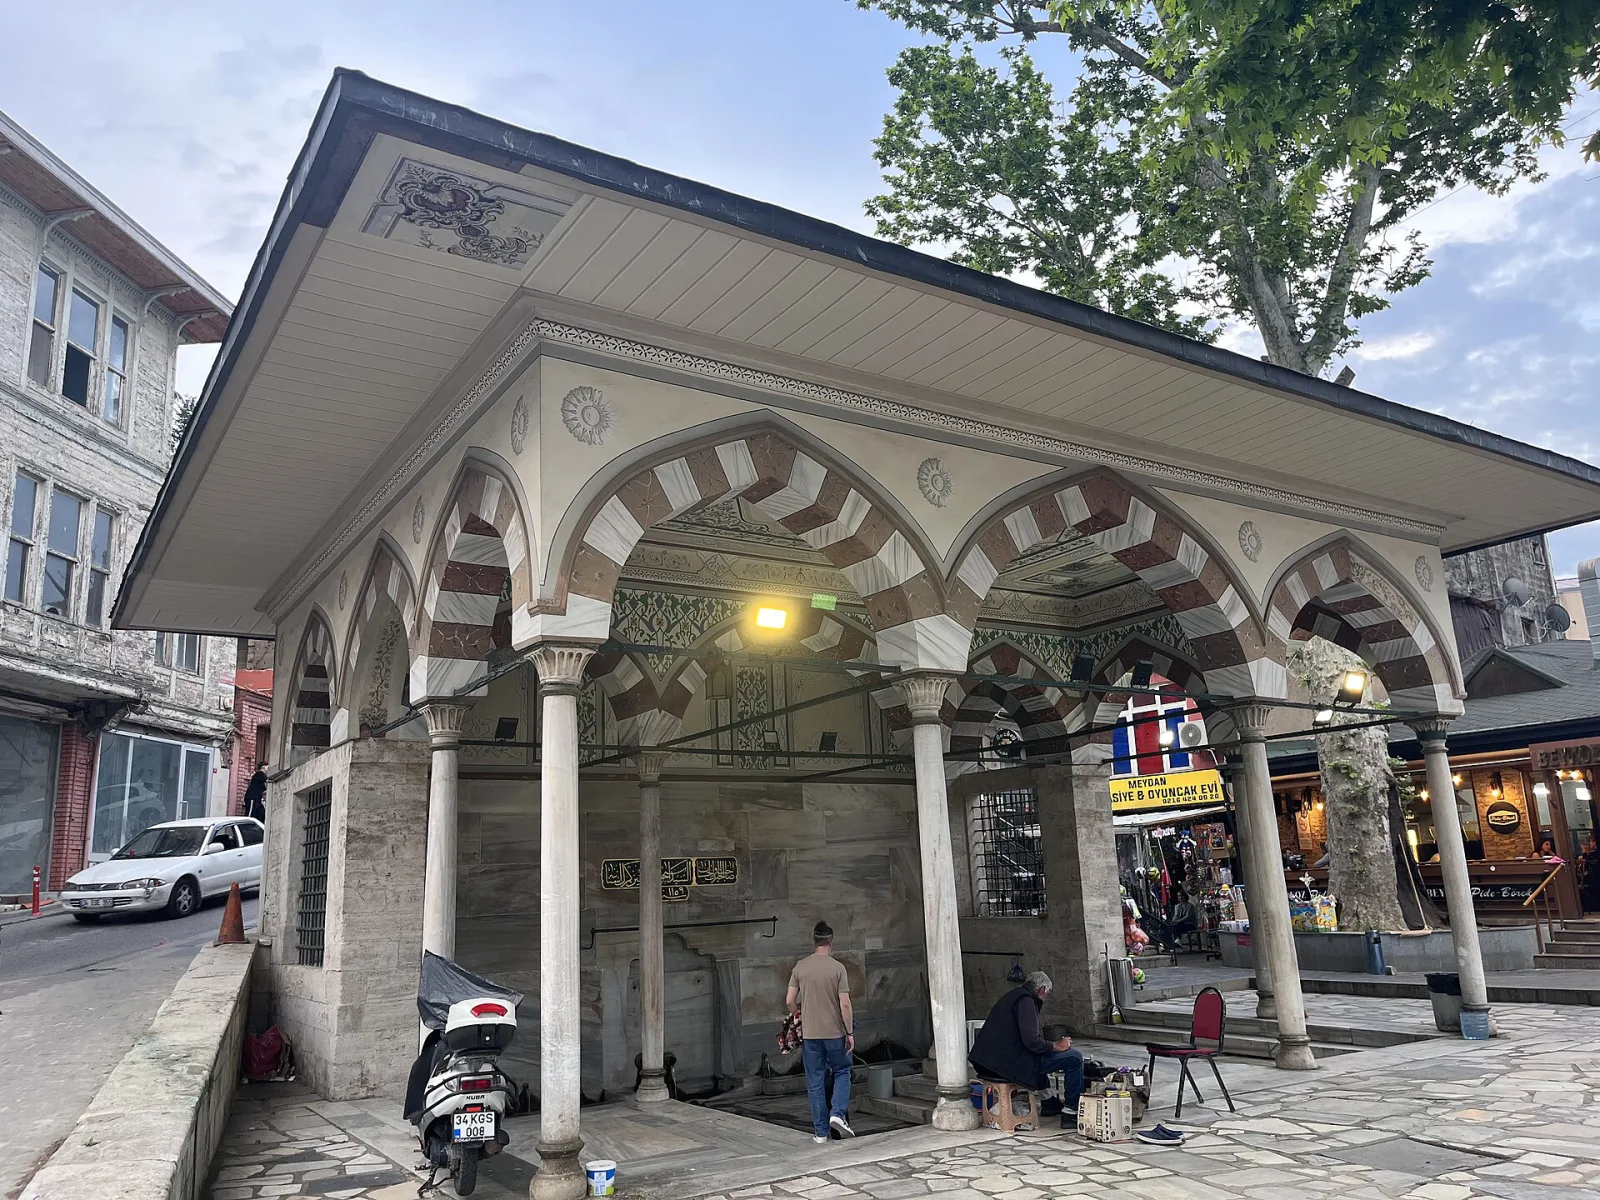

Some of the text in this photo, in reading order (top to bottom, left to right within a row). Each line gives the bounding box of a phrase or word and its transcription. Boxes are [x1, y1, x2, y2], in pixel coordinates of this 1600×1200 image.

[1128, 777, 1167, 789] MEYDAN
[1111, 780, 1218, 803] SİYE & OYUNCAK EVİ
[455, 1112, 494, 1125] 34 KGS
[466, 1126, 485, 1137] 008
